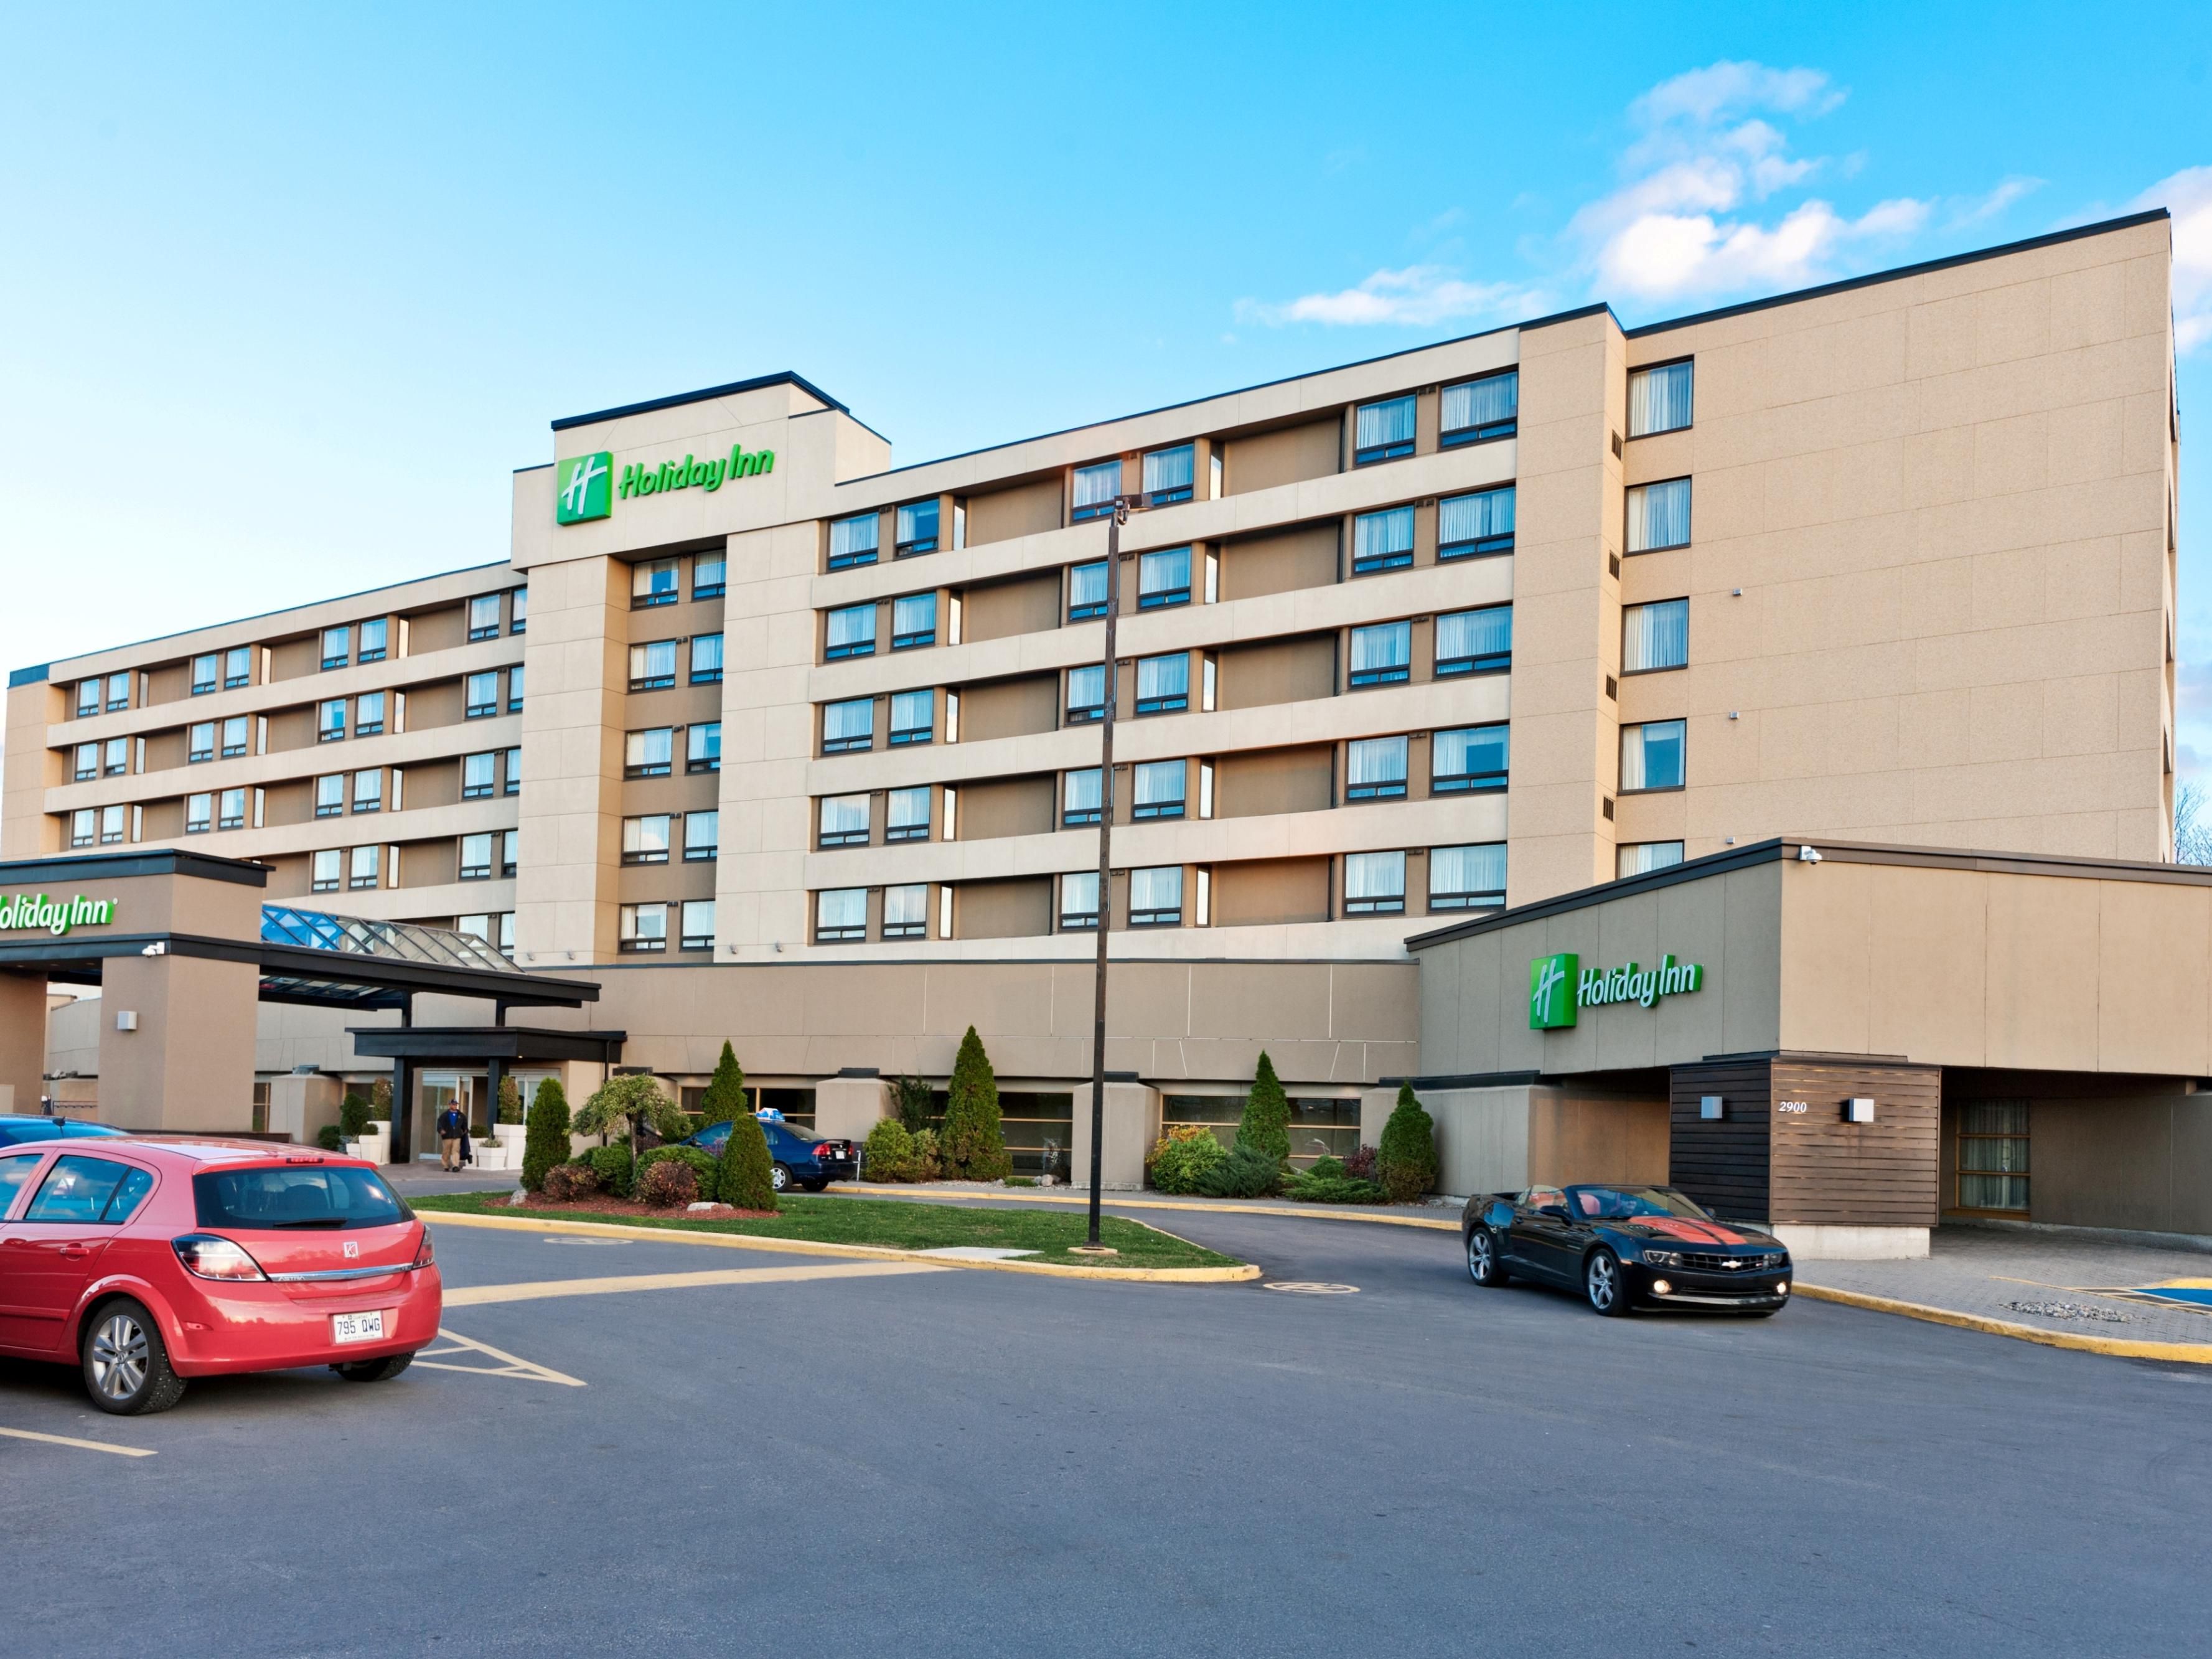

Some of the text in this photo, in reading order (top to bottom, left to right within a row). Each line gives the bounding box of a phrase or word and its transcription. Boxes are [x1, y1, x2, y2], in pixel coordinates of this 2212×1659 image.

[618, 444, 774, 499] Holiday Inn
[0, 893, 114, 935] oliday Inn
[1577, 954, 1702, 1007] Holiday Inn
[1778, 1101, 1807, 1112] 2900
[337, 1318, 380, 1335] 795 QWG
